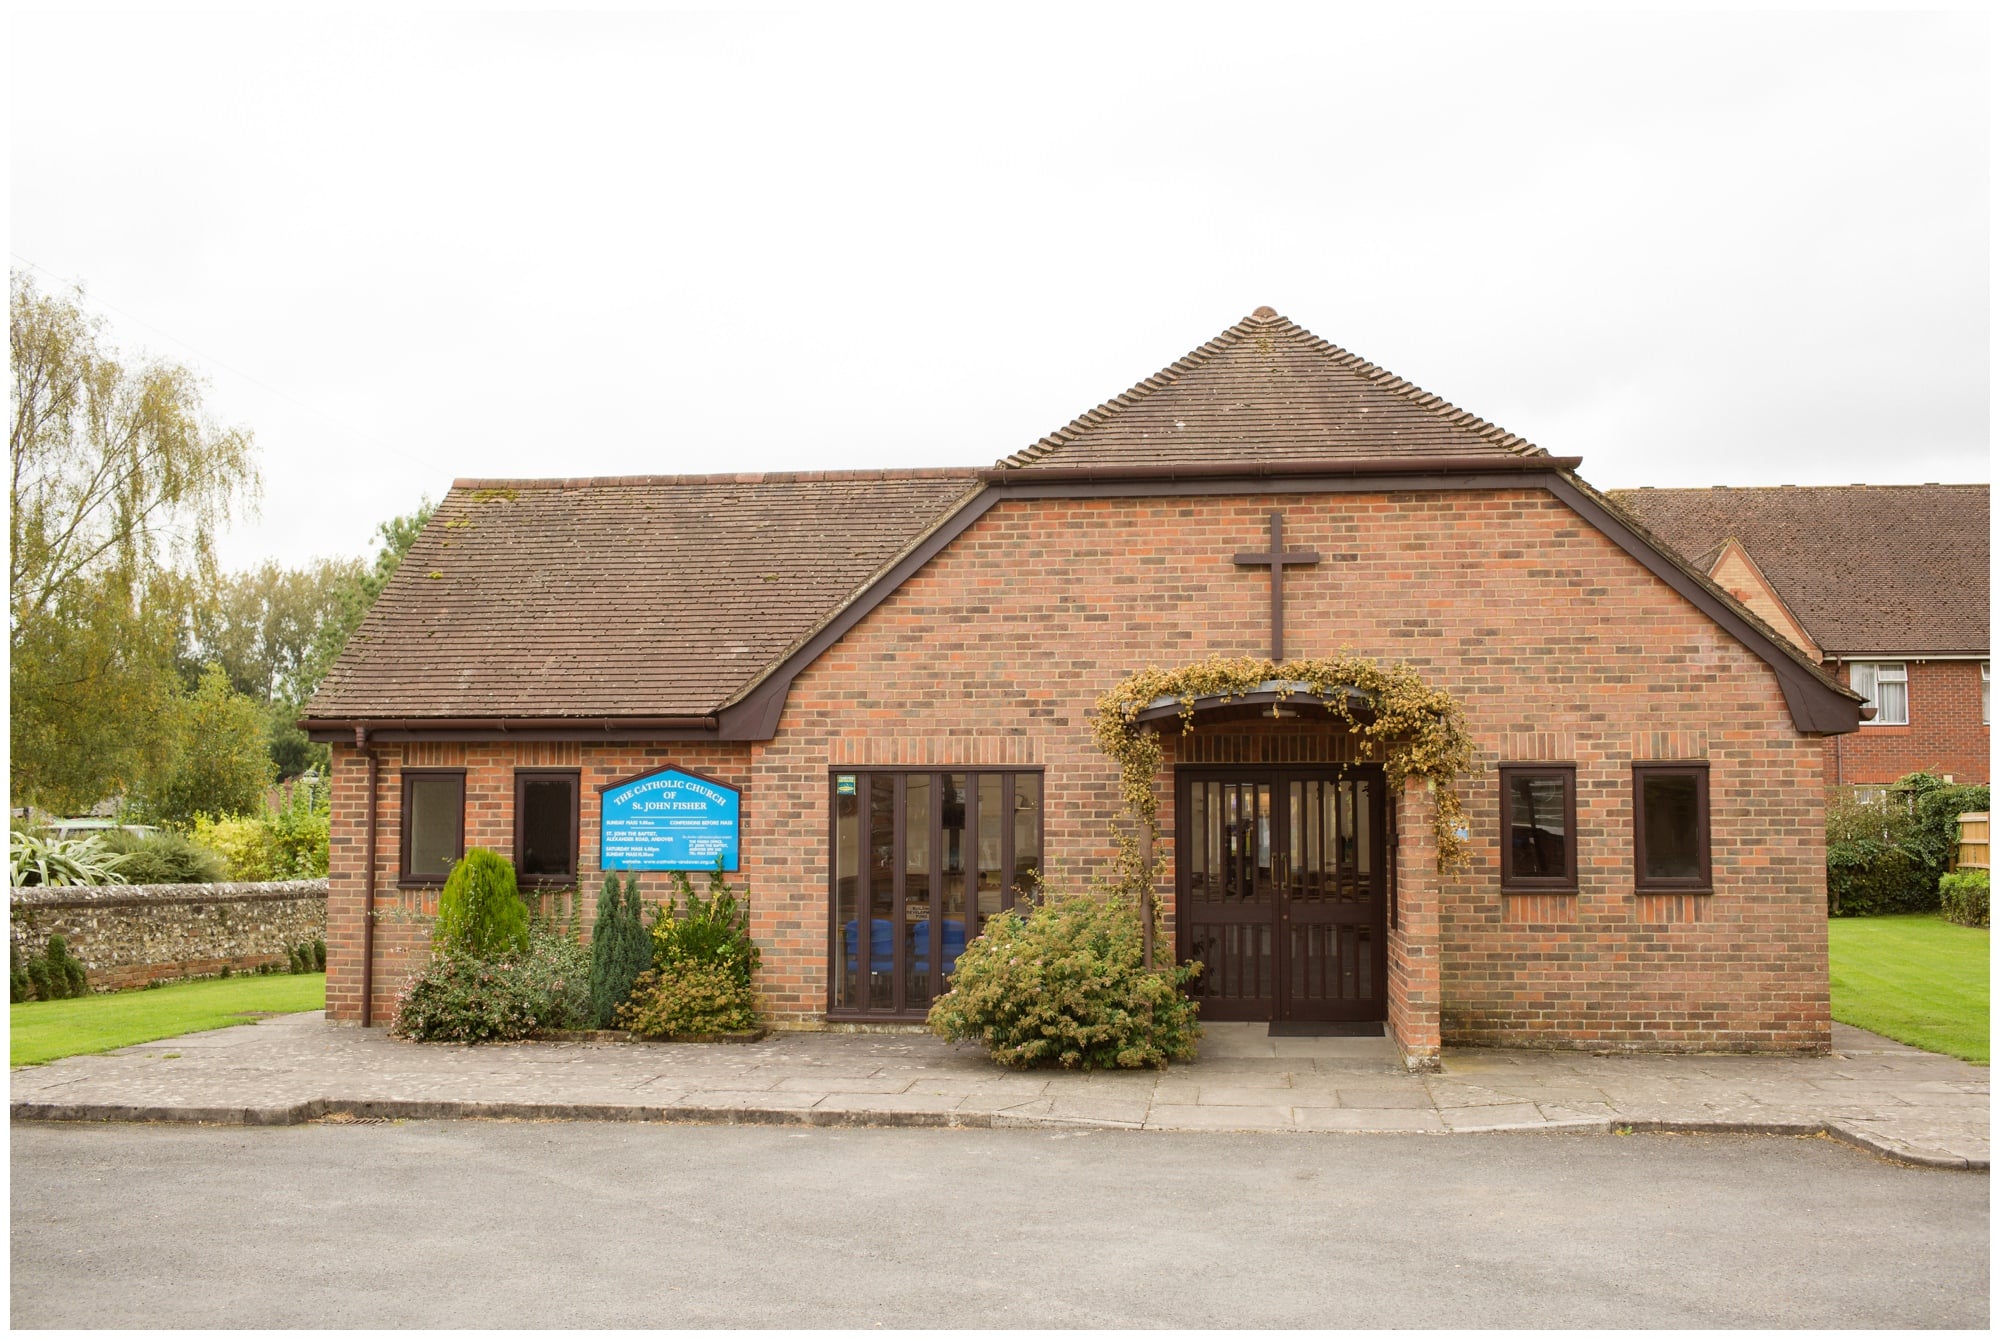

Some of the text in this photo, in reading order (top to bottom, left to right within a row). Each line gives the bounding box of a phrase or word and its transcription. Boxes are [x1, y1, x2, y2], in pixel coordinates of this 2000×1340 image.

[613, 780, 727, 807] THE CATHOLIC CHURCH
[663, 791, 677, 800] OF
[632, 801, 707, 812] St. JOHN FISHER
